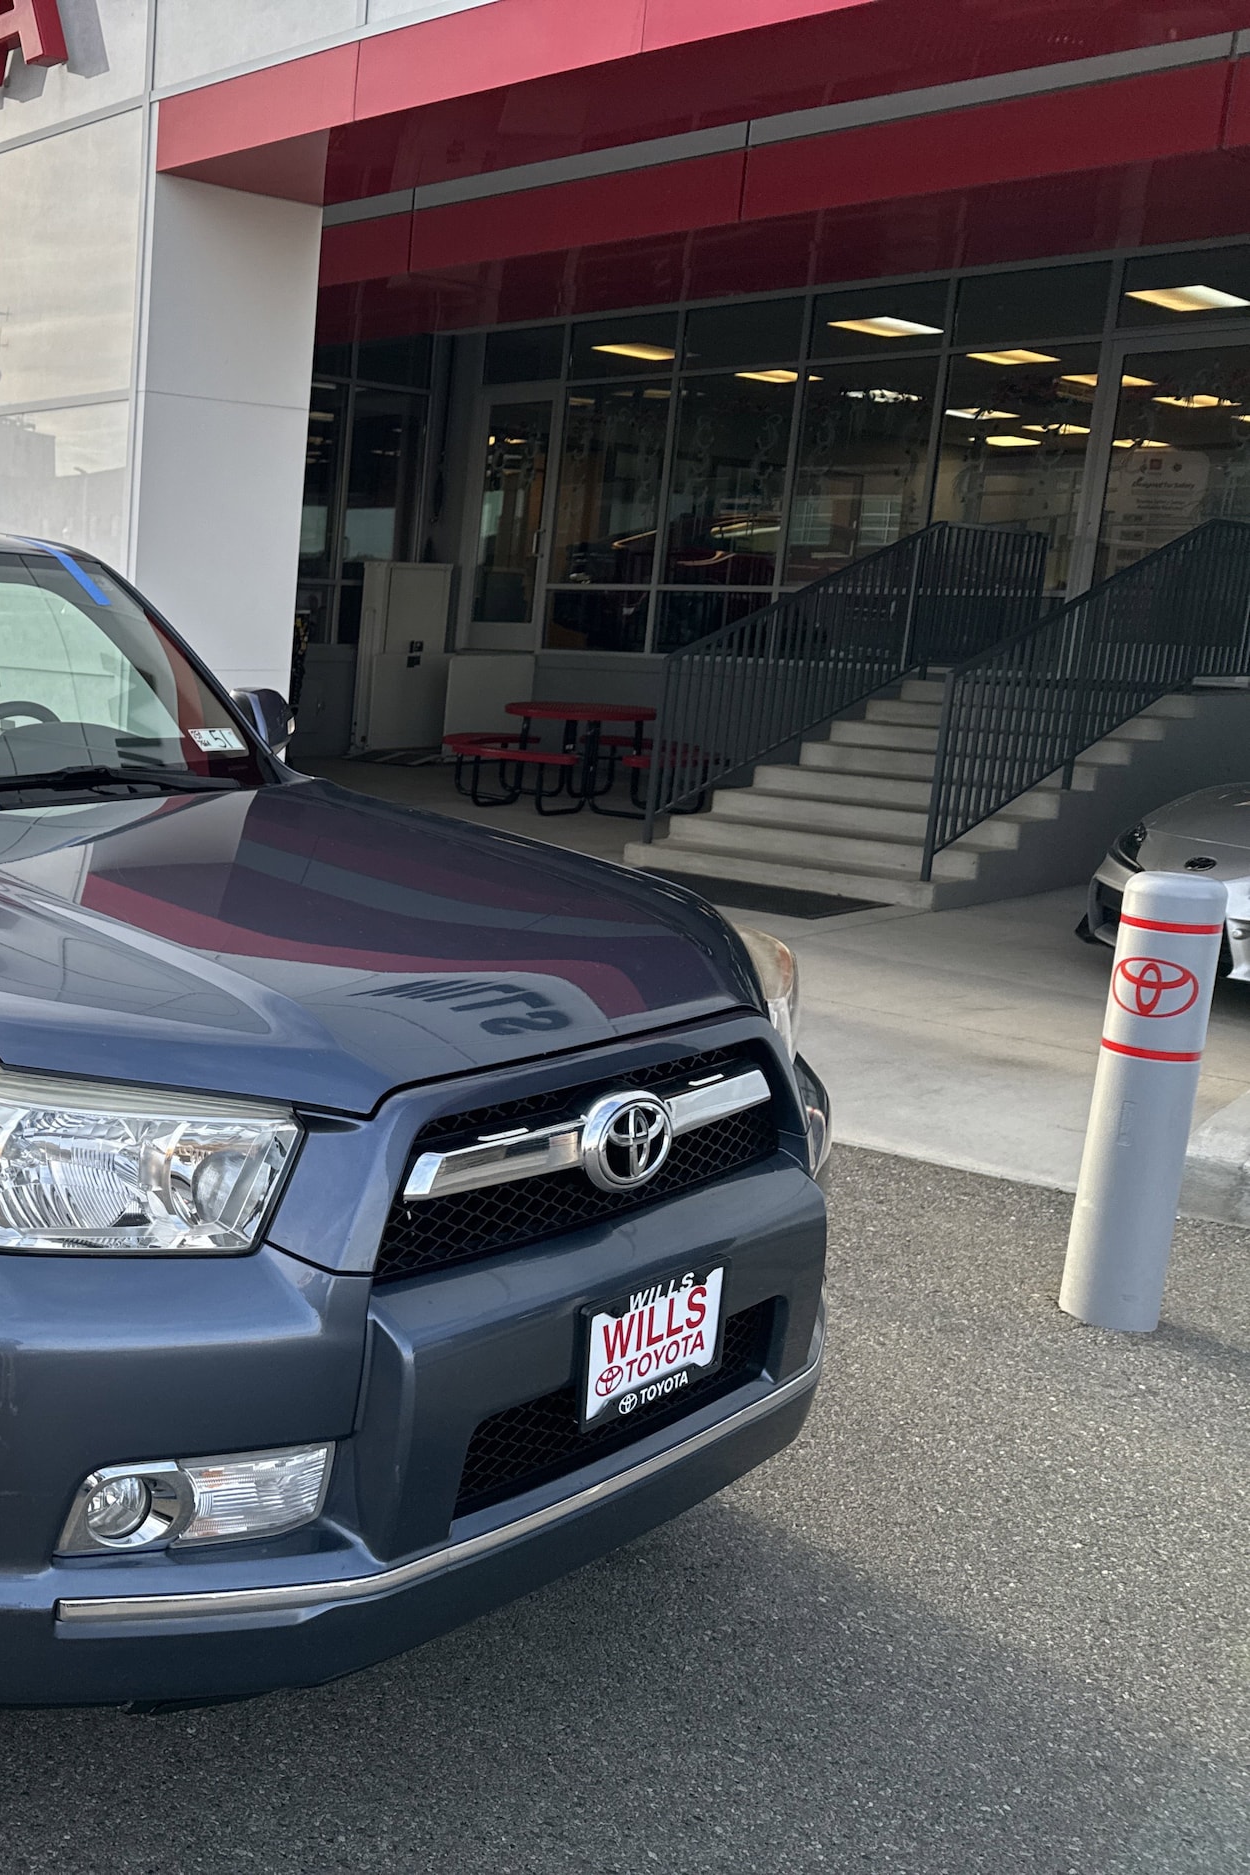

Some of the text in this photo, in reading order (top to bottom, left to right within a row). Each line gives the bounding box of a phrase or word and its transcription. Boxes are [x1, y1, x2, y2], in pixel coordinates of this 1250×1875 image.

[630, 1272, 694, 1311] WILLS
[603, 1285, 708, 1364] WILLS
[626, 1330, 705, 1383] TOYOTA
[640, 1370, 689, 1405] TOYOTA
